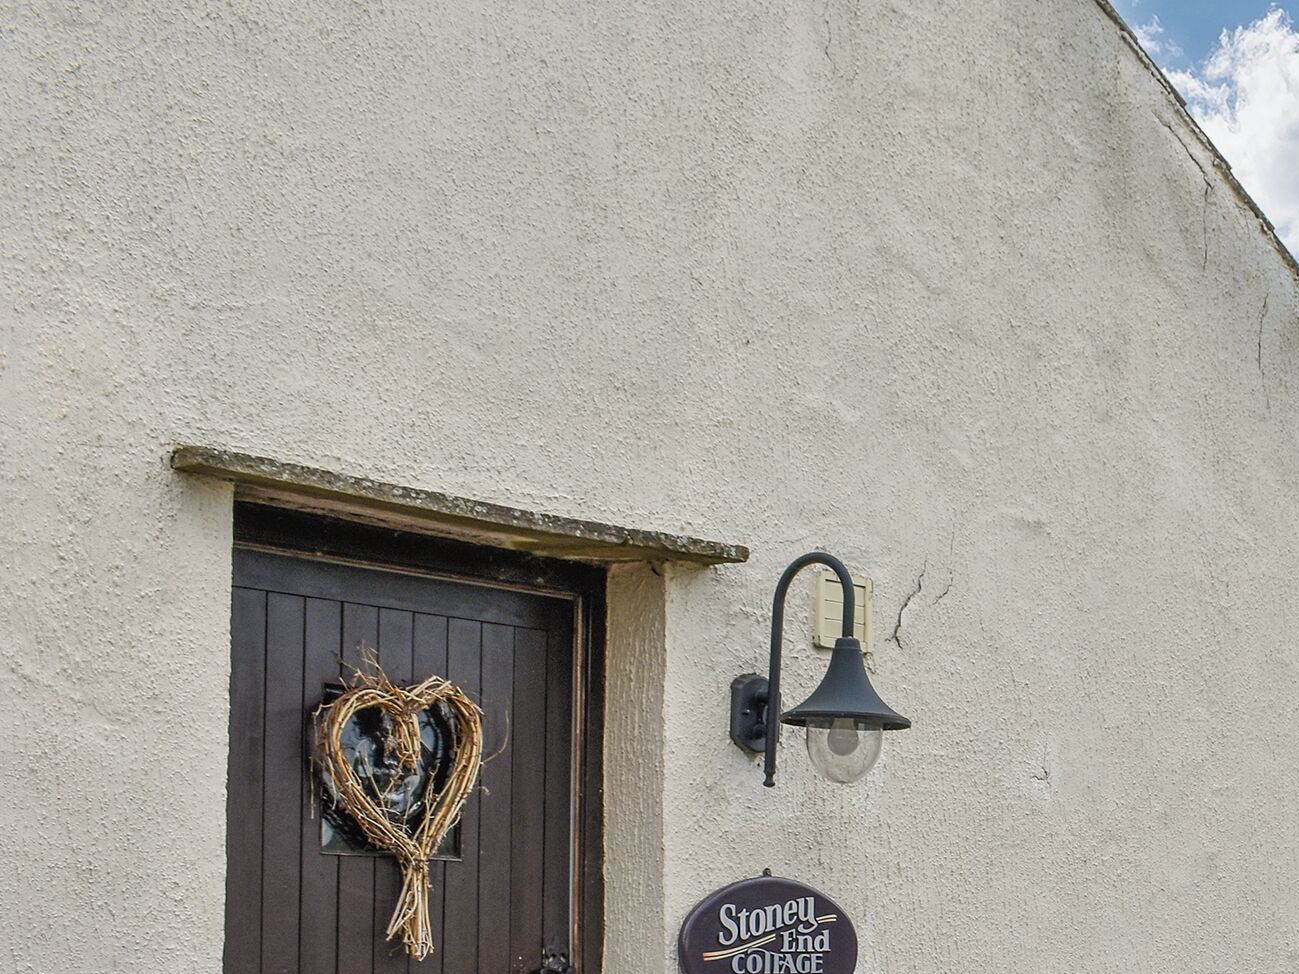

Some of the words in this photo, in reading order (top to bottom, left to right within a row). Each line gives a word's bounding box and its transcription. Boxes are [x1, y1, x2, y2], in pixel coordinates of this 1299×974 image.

[718, 896, 817, 946] Stoney
[780, 929, 831, 952] End
[731, 947, 823, 974] COTTAGE
